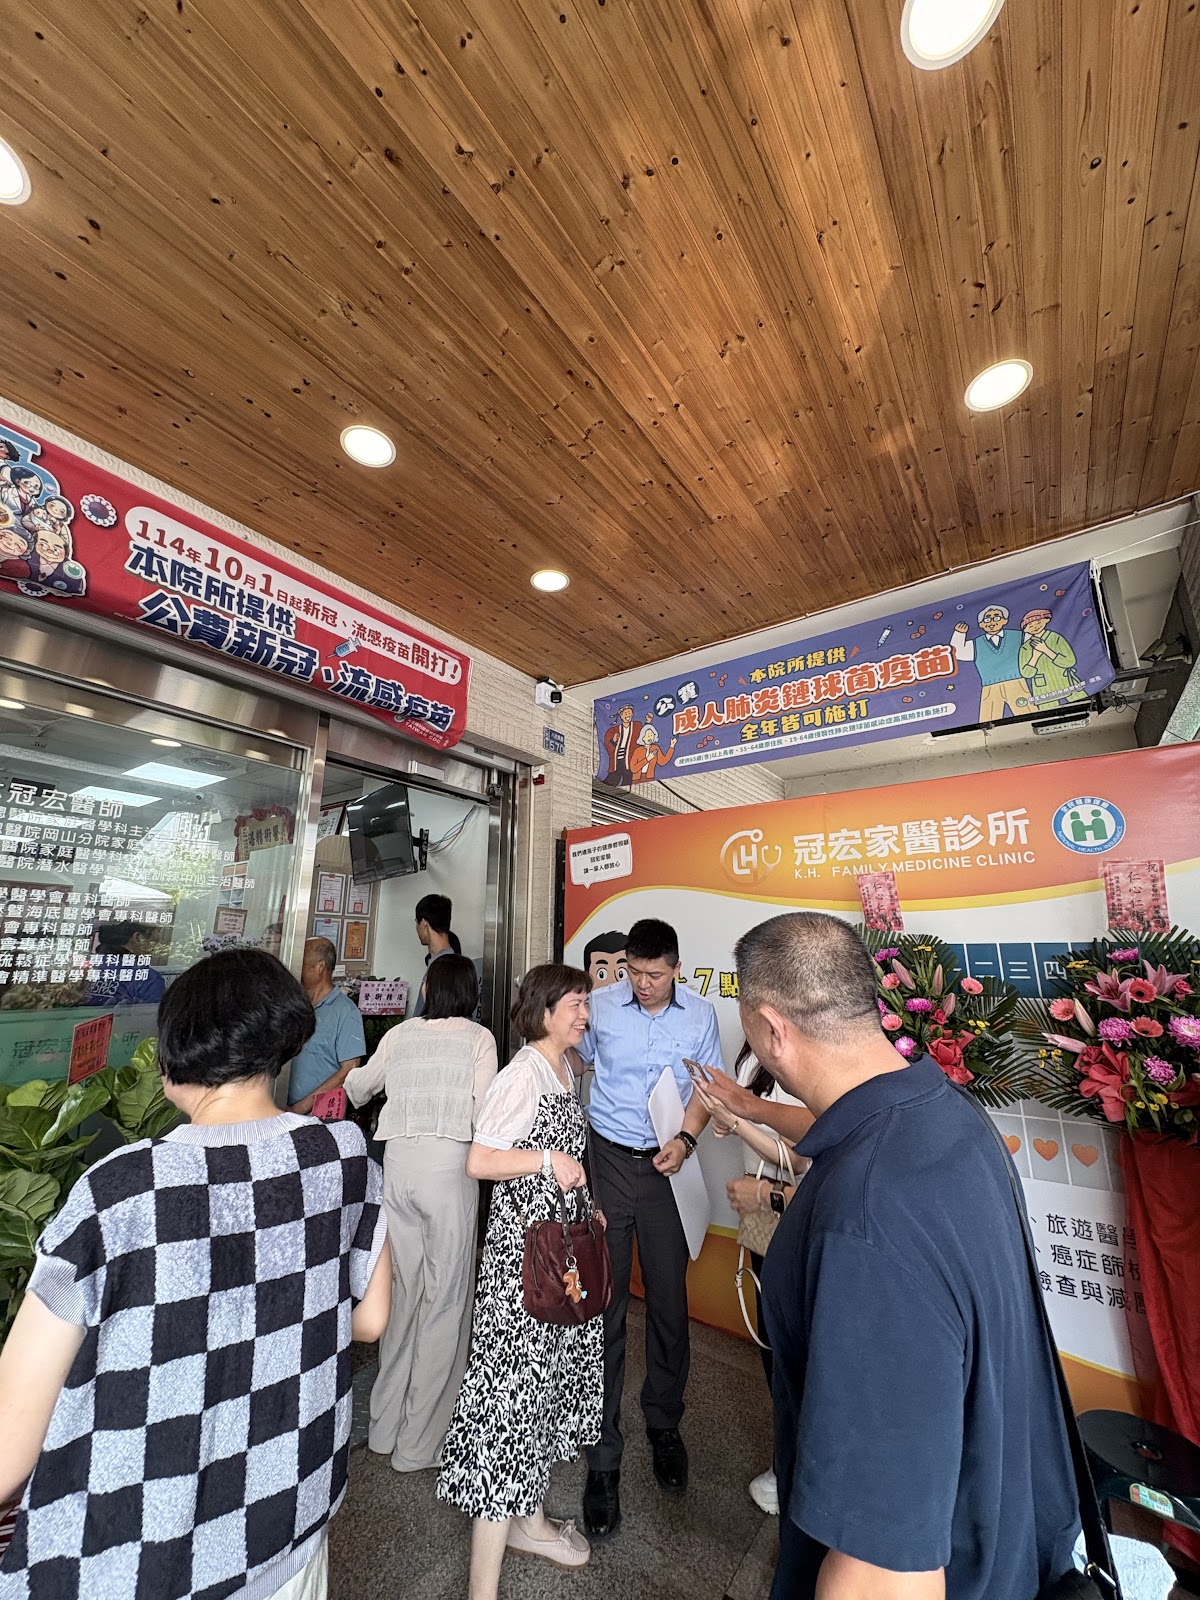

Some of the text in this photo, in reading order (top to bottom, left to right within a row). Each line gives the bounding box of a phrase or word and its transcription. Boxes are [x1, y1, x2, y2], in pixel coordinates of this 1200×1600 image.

[128, 543, 294, 635] 本院所提供
[139, 591, 454, 731] 公費新冠、流感疫苗
[750, 646, 846, 683] 本院所提供
[656, 681, 699, 716] 公費
[674, 647, 951, 733] 成人肺炎鏈球菌疫苗
[405, 722, 428, 737] TAIWAN
[428, 735, 441, 744] CDC
[741, 698, 869, 742] 全年皆可施打
[550, 740, 564, 754] 570
[0, 782, 124, 819] 冠宏醫師
[793, 808, 1030, 866] 冠宏家醫診所
[794, 850, 1036, 879] K.H. FAMILY MEDICINE CLINIC
[1, 937, 91, 952] 會專科醫師
[4, 921, 94, 936] 會專科醫師
[1008, 961, 1031, 979] 三
[1043, 961, 1067, 980] 四
